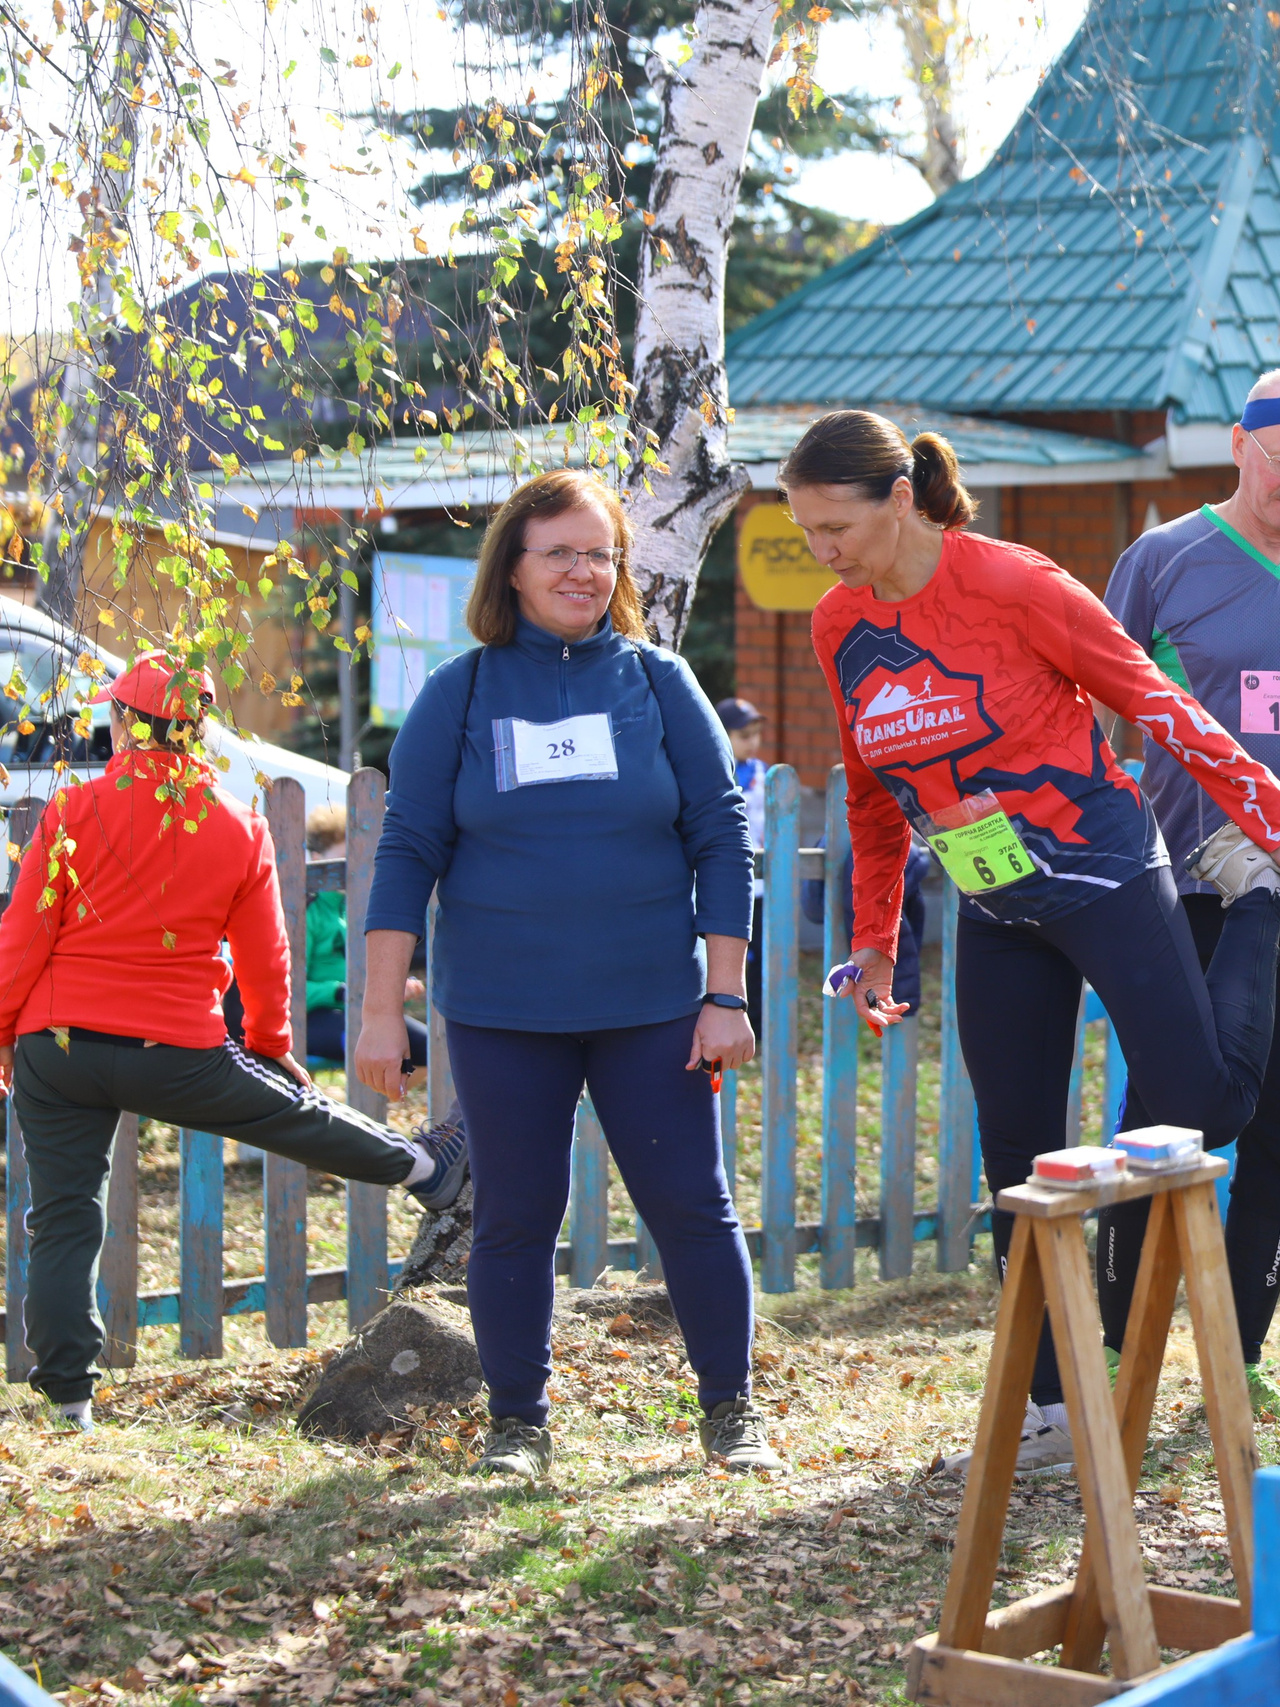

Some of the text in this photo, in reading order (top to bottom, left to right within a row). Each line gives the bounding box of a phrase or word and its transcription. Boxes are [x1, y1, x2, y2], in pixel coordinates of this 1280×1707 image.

[546, 738, 576, 760] 28
[955, 817, 1003, 839] ГОРЯЧАЯ ДЕСЯТКА
[998, 842, 1018, 855] ЭТАП
[973, 856, 996, 885] 6
[1008, 853, 1023, 873] 6
